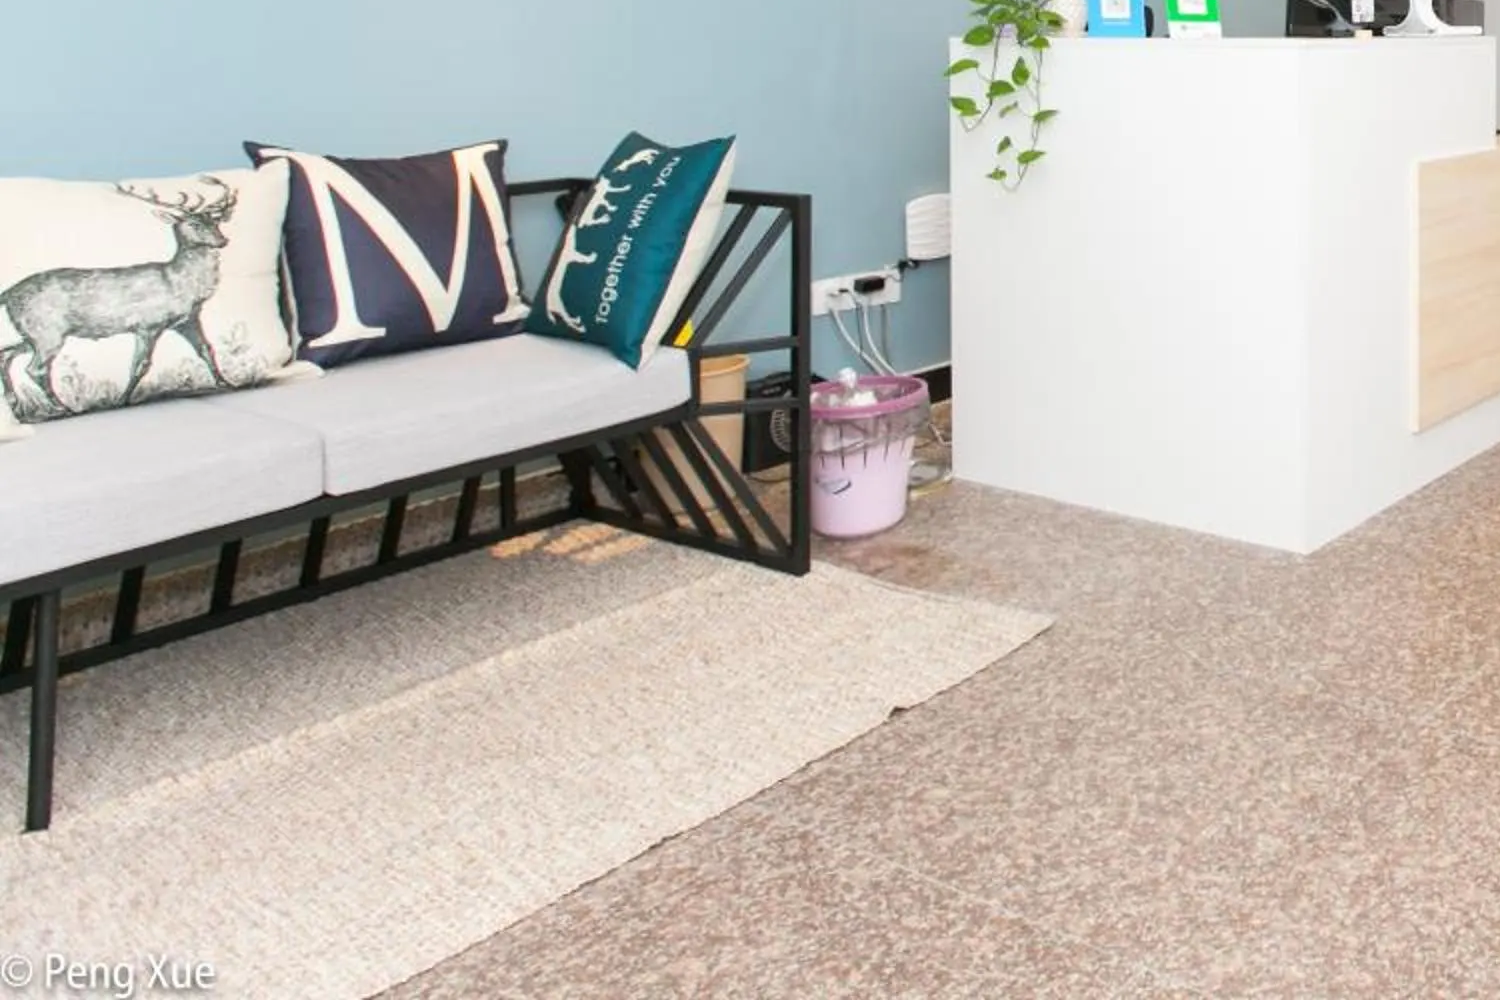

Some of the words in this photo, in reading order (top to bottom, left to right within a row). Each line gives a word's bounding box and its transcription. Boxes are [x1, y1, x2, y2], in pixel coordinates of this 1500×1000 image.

[258, 142, 533, 348] M
[627, 192, 657, 230] with
[654, 156, 683, 189] you
